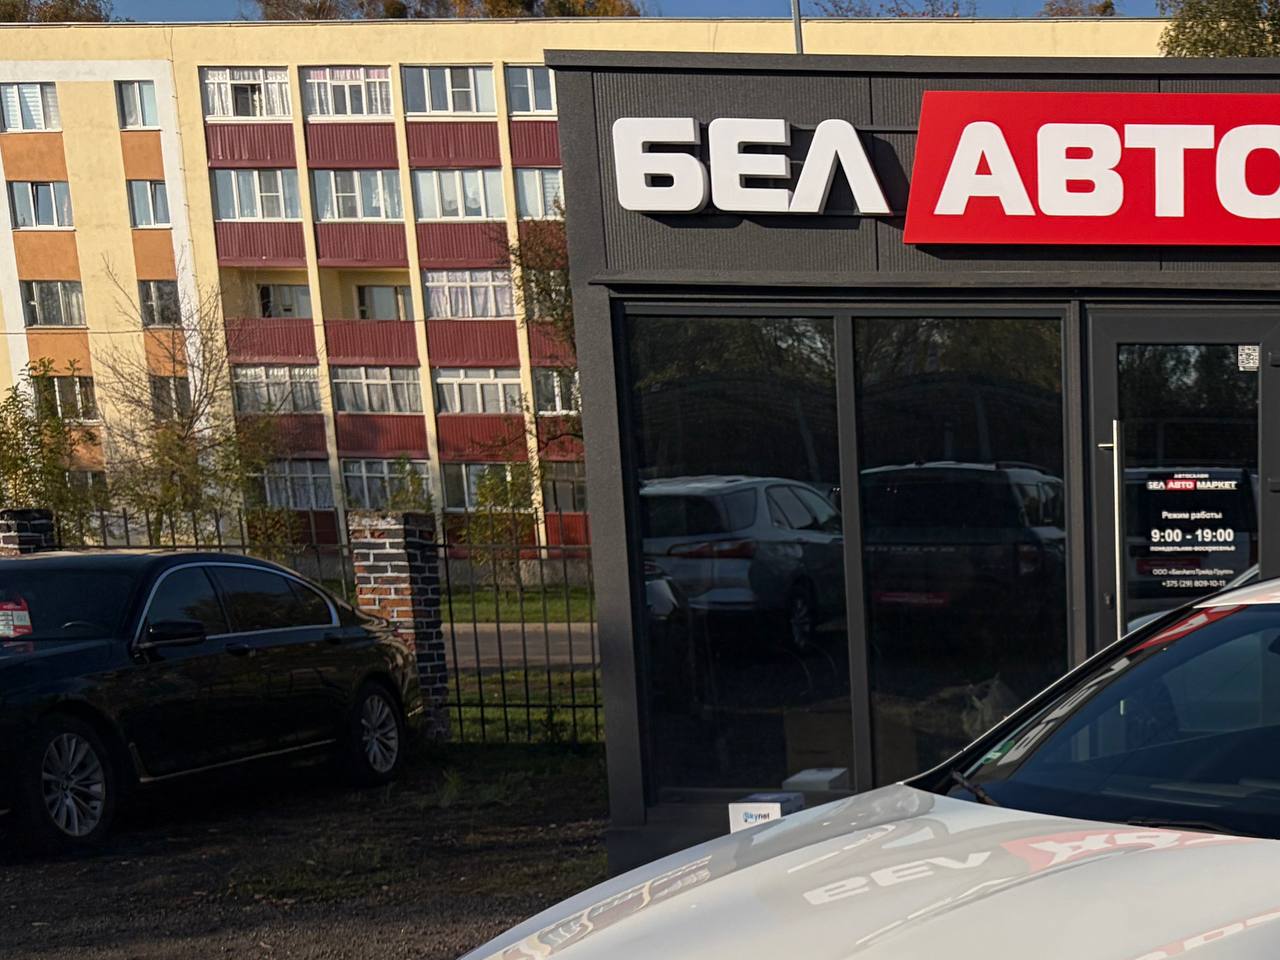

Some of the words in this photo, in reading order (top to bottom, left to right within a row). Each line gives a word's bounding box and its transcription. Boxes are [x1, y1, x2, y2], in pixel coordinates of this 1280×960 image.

[612, 117, 894, 215] БЕЛ
[1167, 481, 1195, 490] АВТО
[1196, 481, 1238, 490] МАРКЕТ
[1162, 511, 1189, 519] Режим
[1191, 511, 1222, 520] работы
[1150, 528, 1182, 542] 9:00
[1195, 528, 1234, 542] 19:00
[1152, 568, 1168, 576] ООО
[1161, 580, 1179, 588] +375
[1179, 580, 1193, 588] (29)
